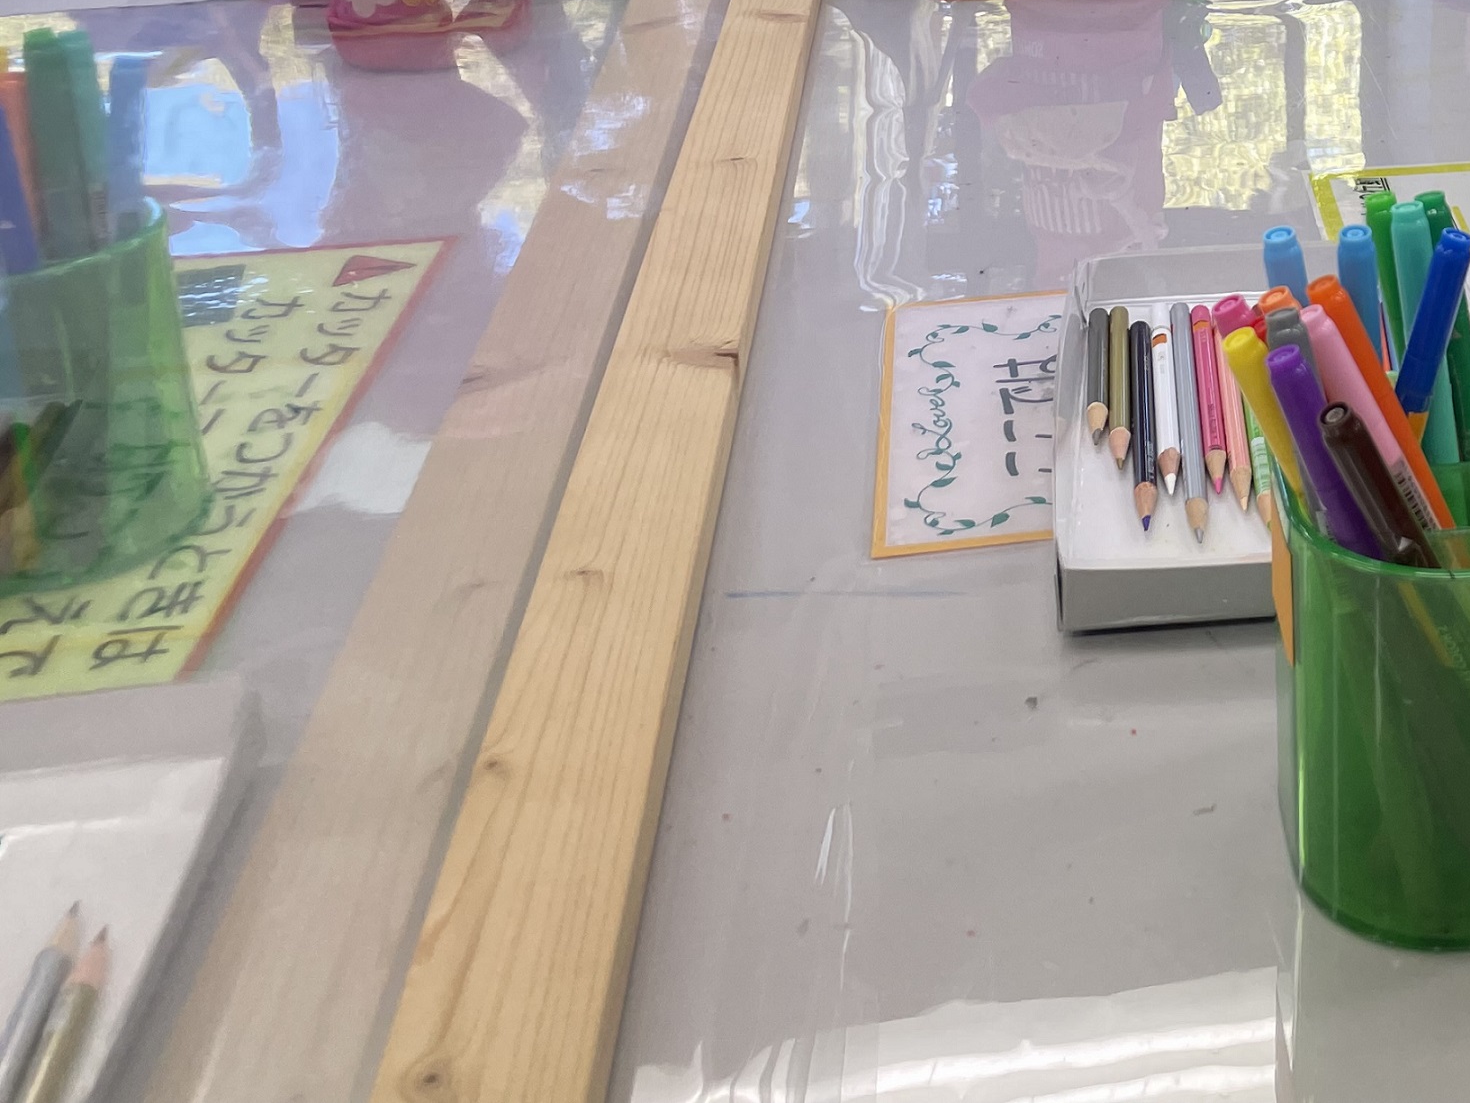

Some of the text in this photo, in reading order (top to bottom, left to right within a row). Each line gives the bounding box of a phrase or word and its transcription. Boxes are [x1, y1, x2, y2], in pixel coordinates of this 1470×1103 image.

[92, 287, 391, 672] カッターをつかうときは
